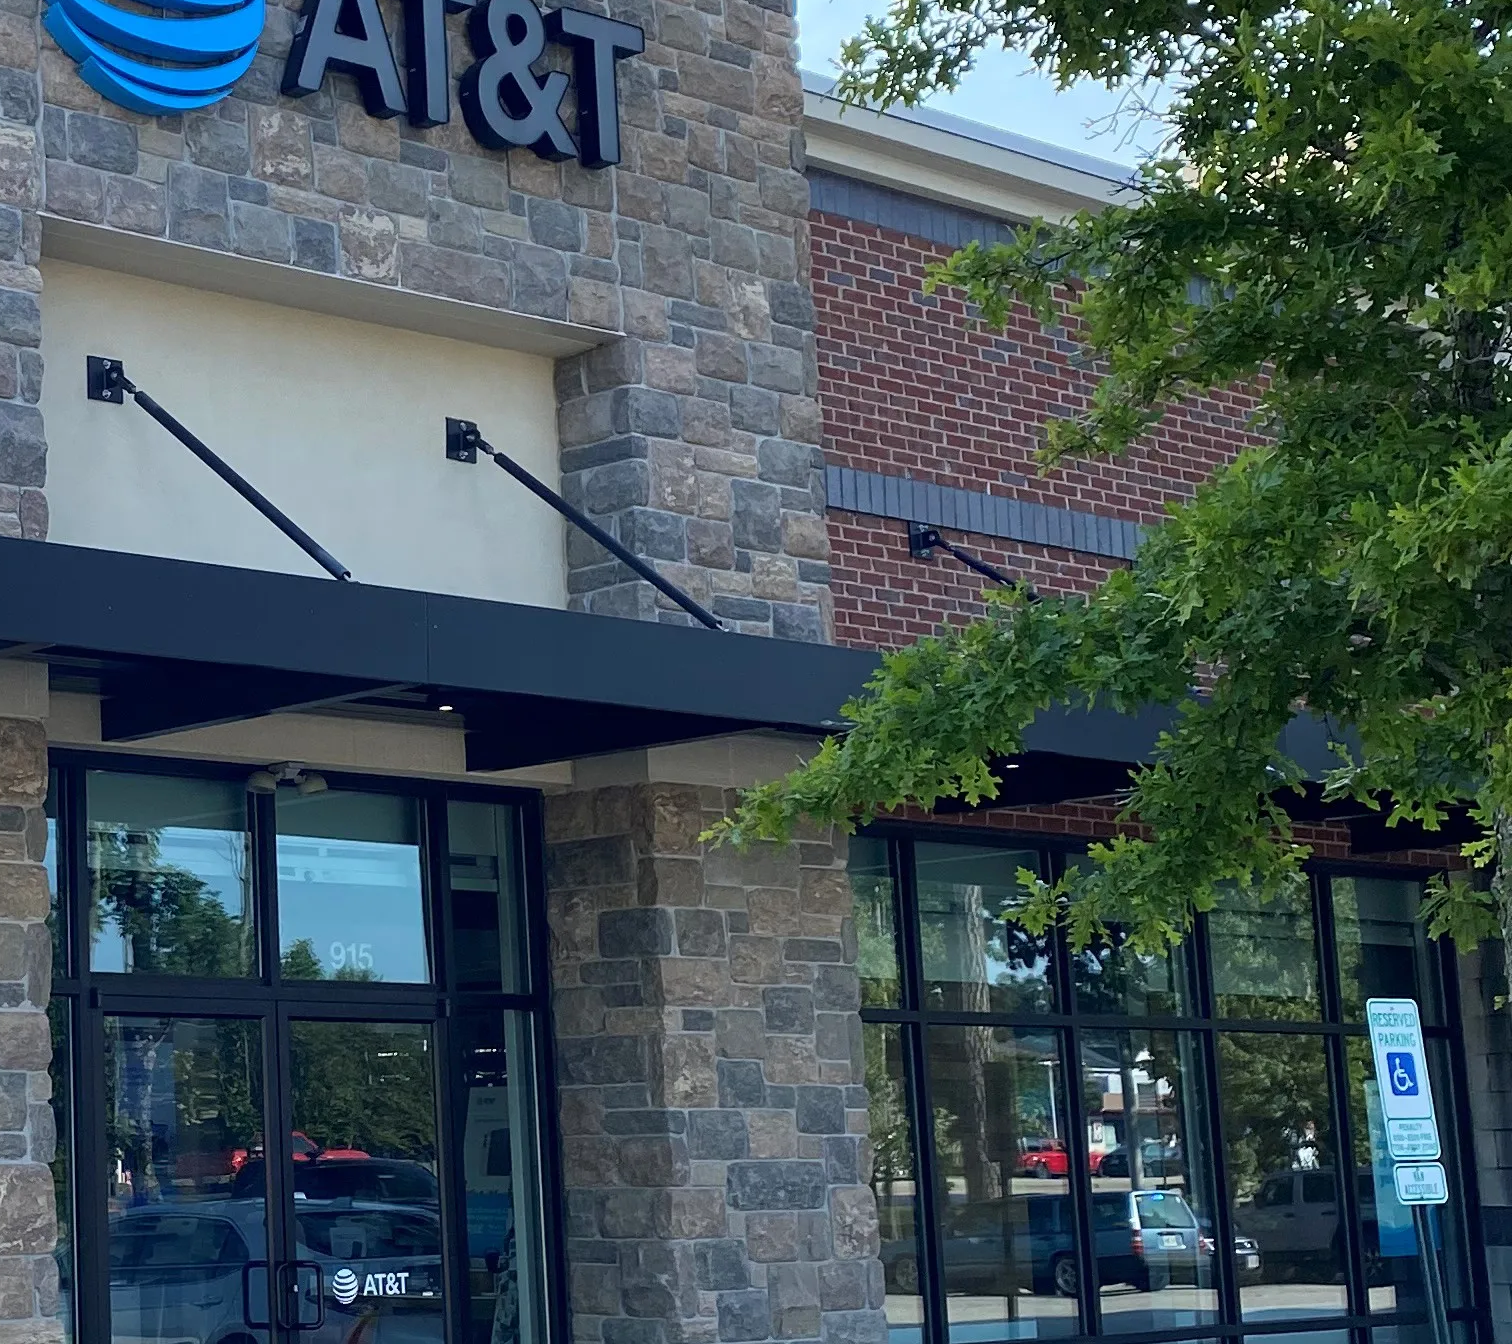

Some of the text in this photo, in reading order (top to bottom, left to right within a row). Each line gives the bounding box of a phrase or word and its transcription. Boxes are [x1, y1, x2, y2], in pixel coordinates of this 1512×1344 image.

[330, 941, 374, 969] 915
[1372, 1012, 1416, 1027] RESERVED
[1378, 1032, 1417, 1047] PARKING
[363, 1272, 409, 1296] AT&T
